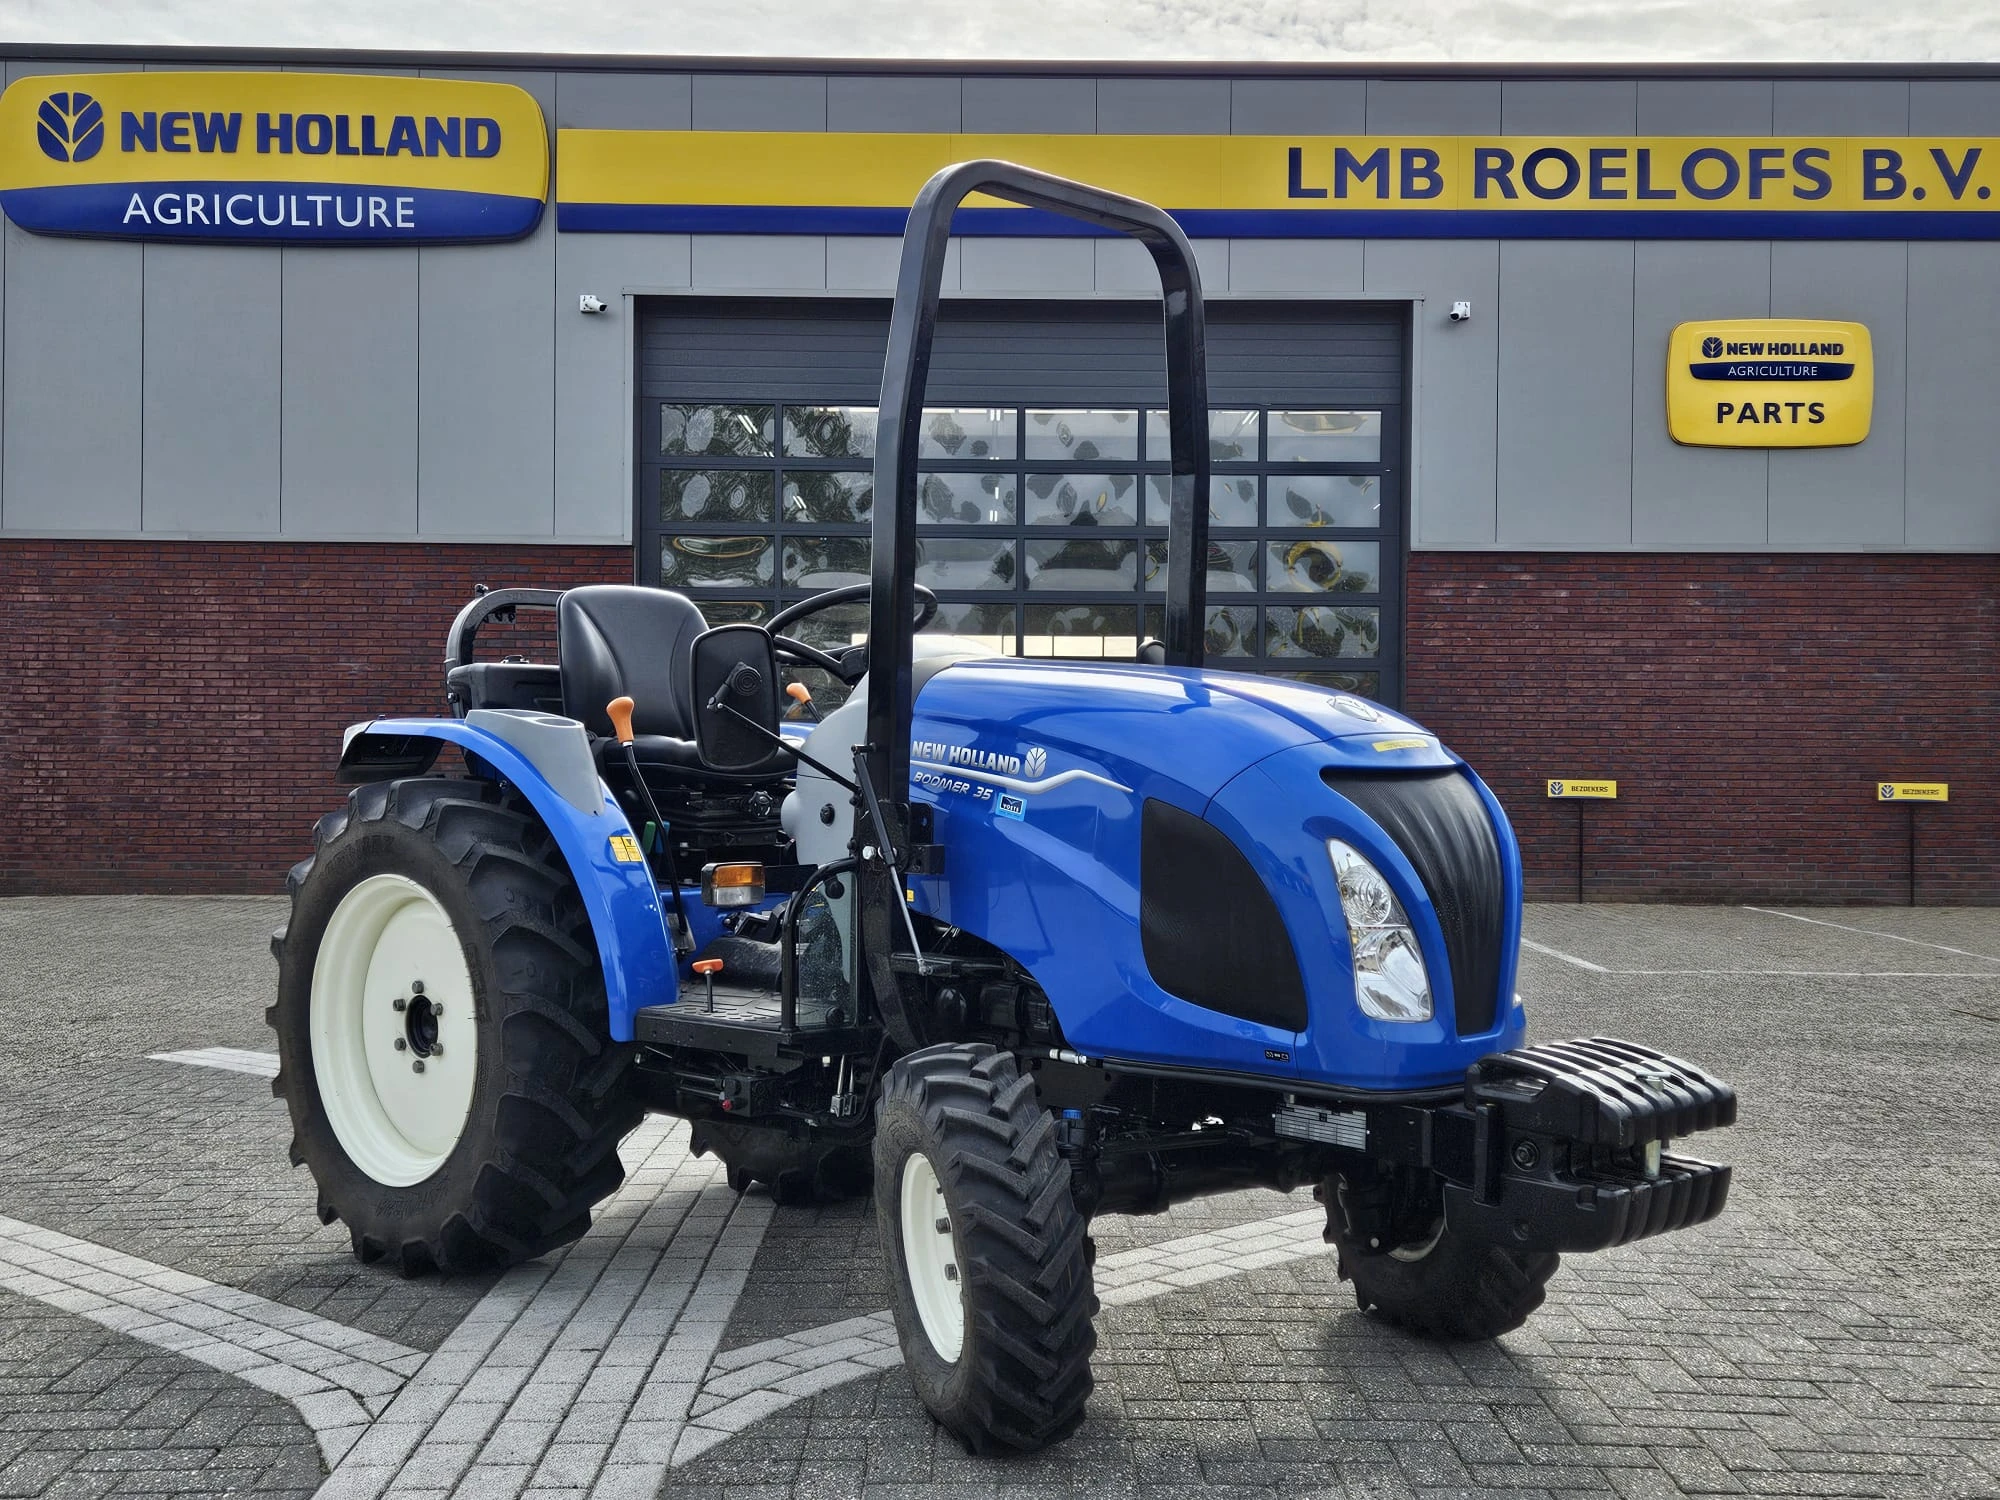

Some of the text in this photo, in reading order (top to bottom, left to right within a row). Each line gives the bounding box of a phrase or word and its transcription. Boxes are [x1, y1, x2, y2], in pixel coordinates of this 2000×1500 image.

[120, 111, 501, 159] NEW HOLLAND
[1288, 146, 1992, 201] LMB ROELOFS B.V.
[122, 192, 416, 229] AGRICULTURE
[1726, 342, 1845, 357] NEW HOLLAND
[1727, 365, 1818, 377] AGRICULTURE
[1716, 402, 1826, 424] PARTS
[911, 740, 1021, 776] NEW HOLLAND
[912, 771, 994, 801] BOOMER 35
